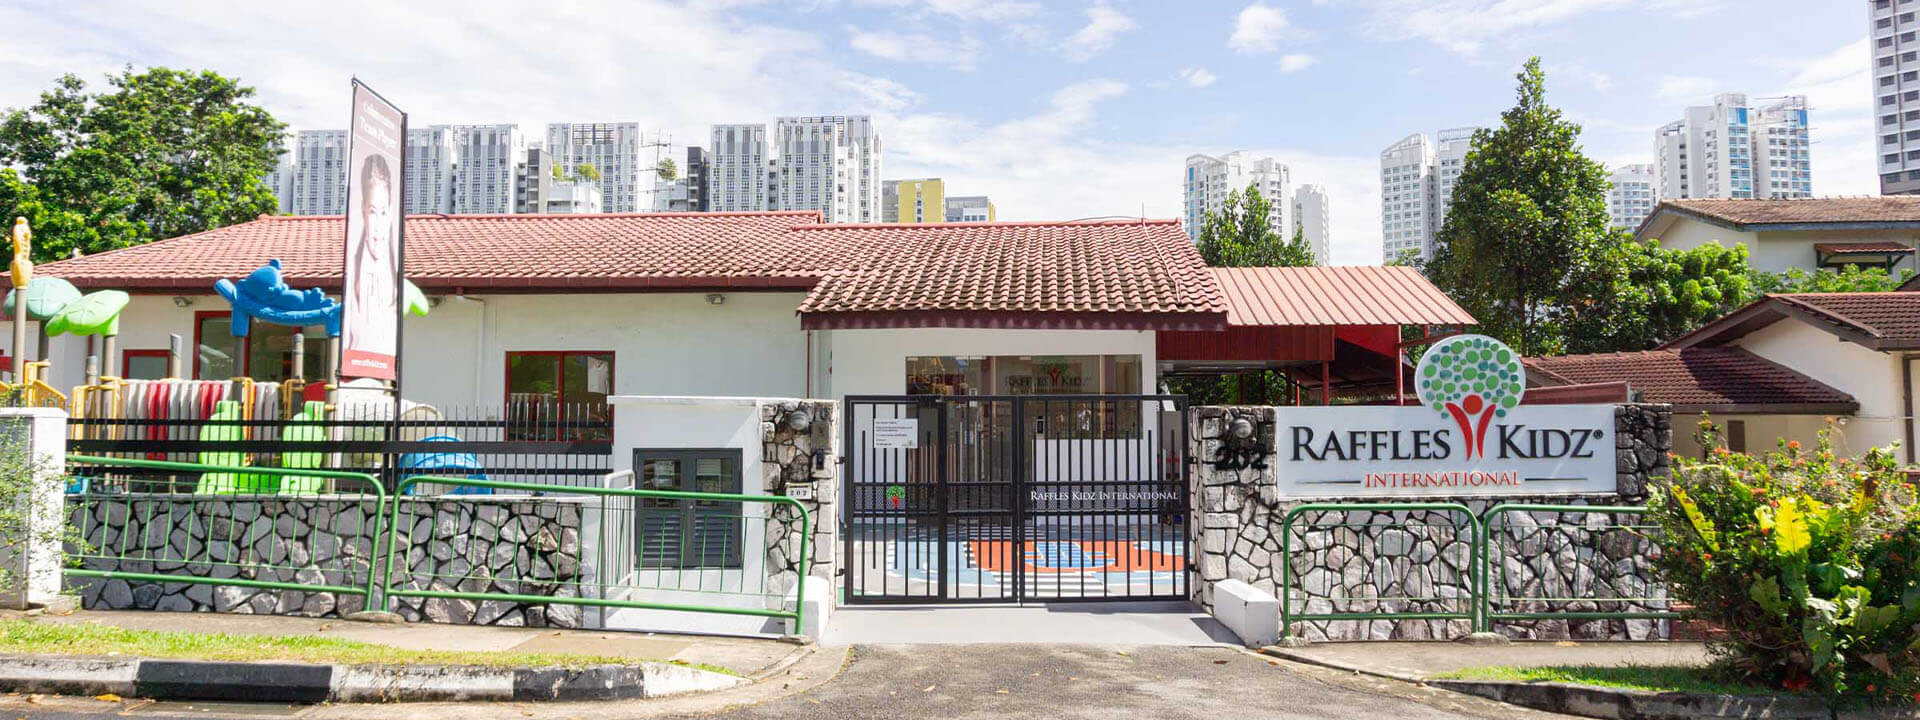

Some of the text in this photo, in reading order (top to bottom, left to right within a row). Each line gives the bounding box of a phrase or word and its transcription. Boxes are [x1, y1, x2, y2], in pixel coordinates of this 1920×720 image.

[1289, 425, 1451, 461] RAFFLES
[1215, 444, 1269, 471] 202
[1364, 471, 1522, 488] INTERNATIONAL
[1030, 490, 1179, 501] RAFFLES KIDZ INTERNATIONAL
